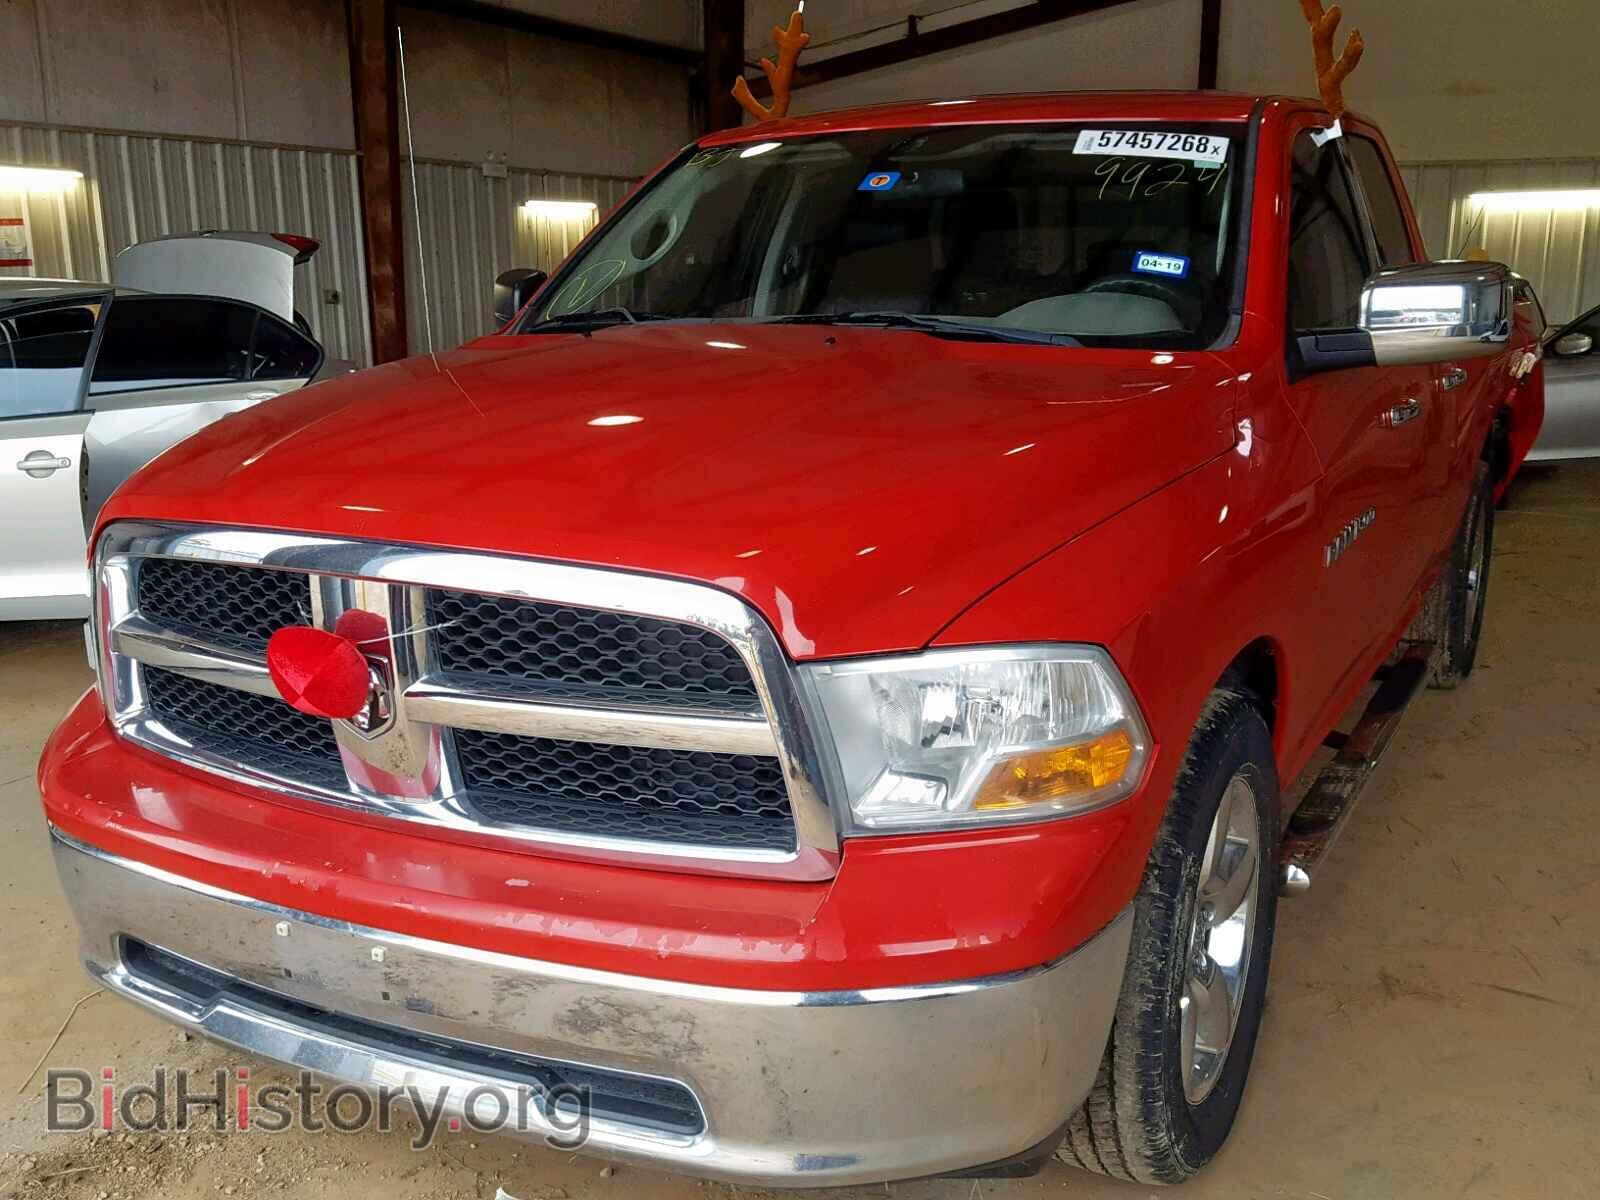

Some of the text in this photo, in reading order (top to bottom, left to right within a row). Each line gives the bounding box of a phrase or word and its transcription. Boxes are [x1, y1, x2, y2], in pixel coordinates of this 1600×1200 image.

[1098, 131, 1209, 153] 57457268
[1092, 156, 1228, 201] 9924
[1141, 257, 1182, 272] 04-19
